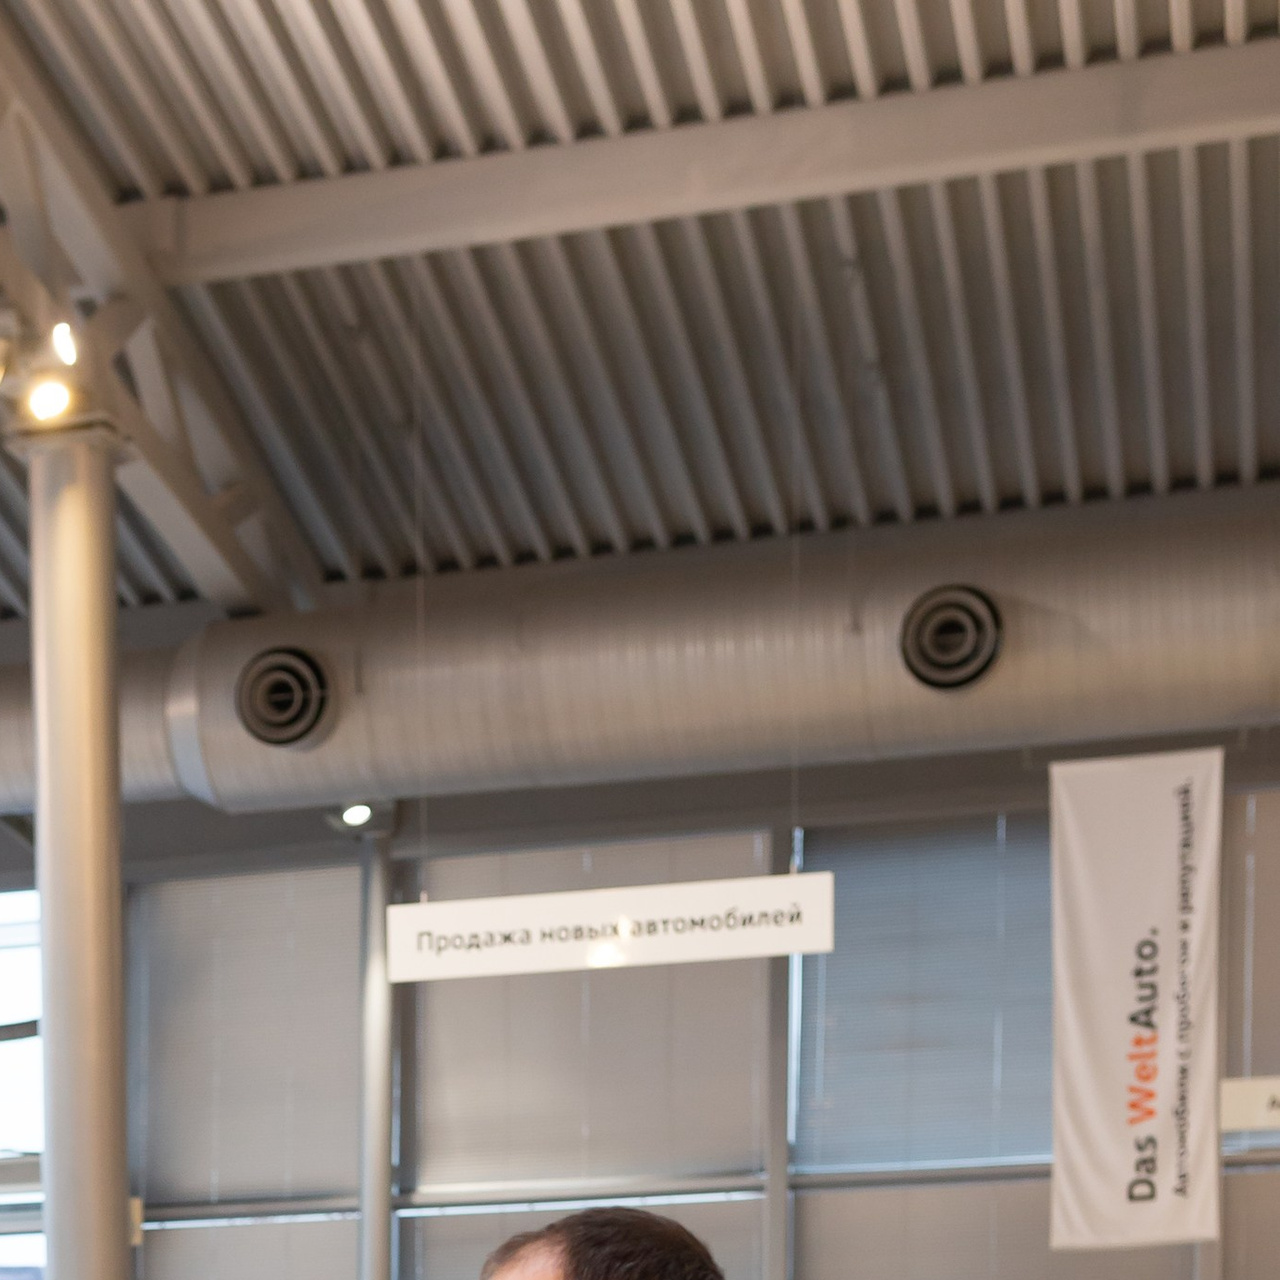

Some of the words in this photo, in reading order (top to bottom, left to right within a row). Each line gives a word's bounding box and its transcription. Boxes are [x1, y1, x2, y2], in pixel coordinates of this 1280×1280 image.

[416, 926, 531, 956] Продажа
[540, 918, 619, 944] новых
[631, 901, 804, 937] автомобилей
[1127, 926, 1160, 1127] WeltAuto.
[1128, 1135, 1159, 1204] Das
